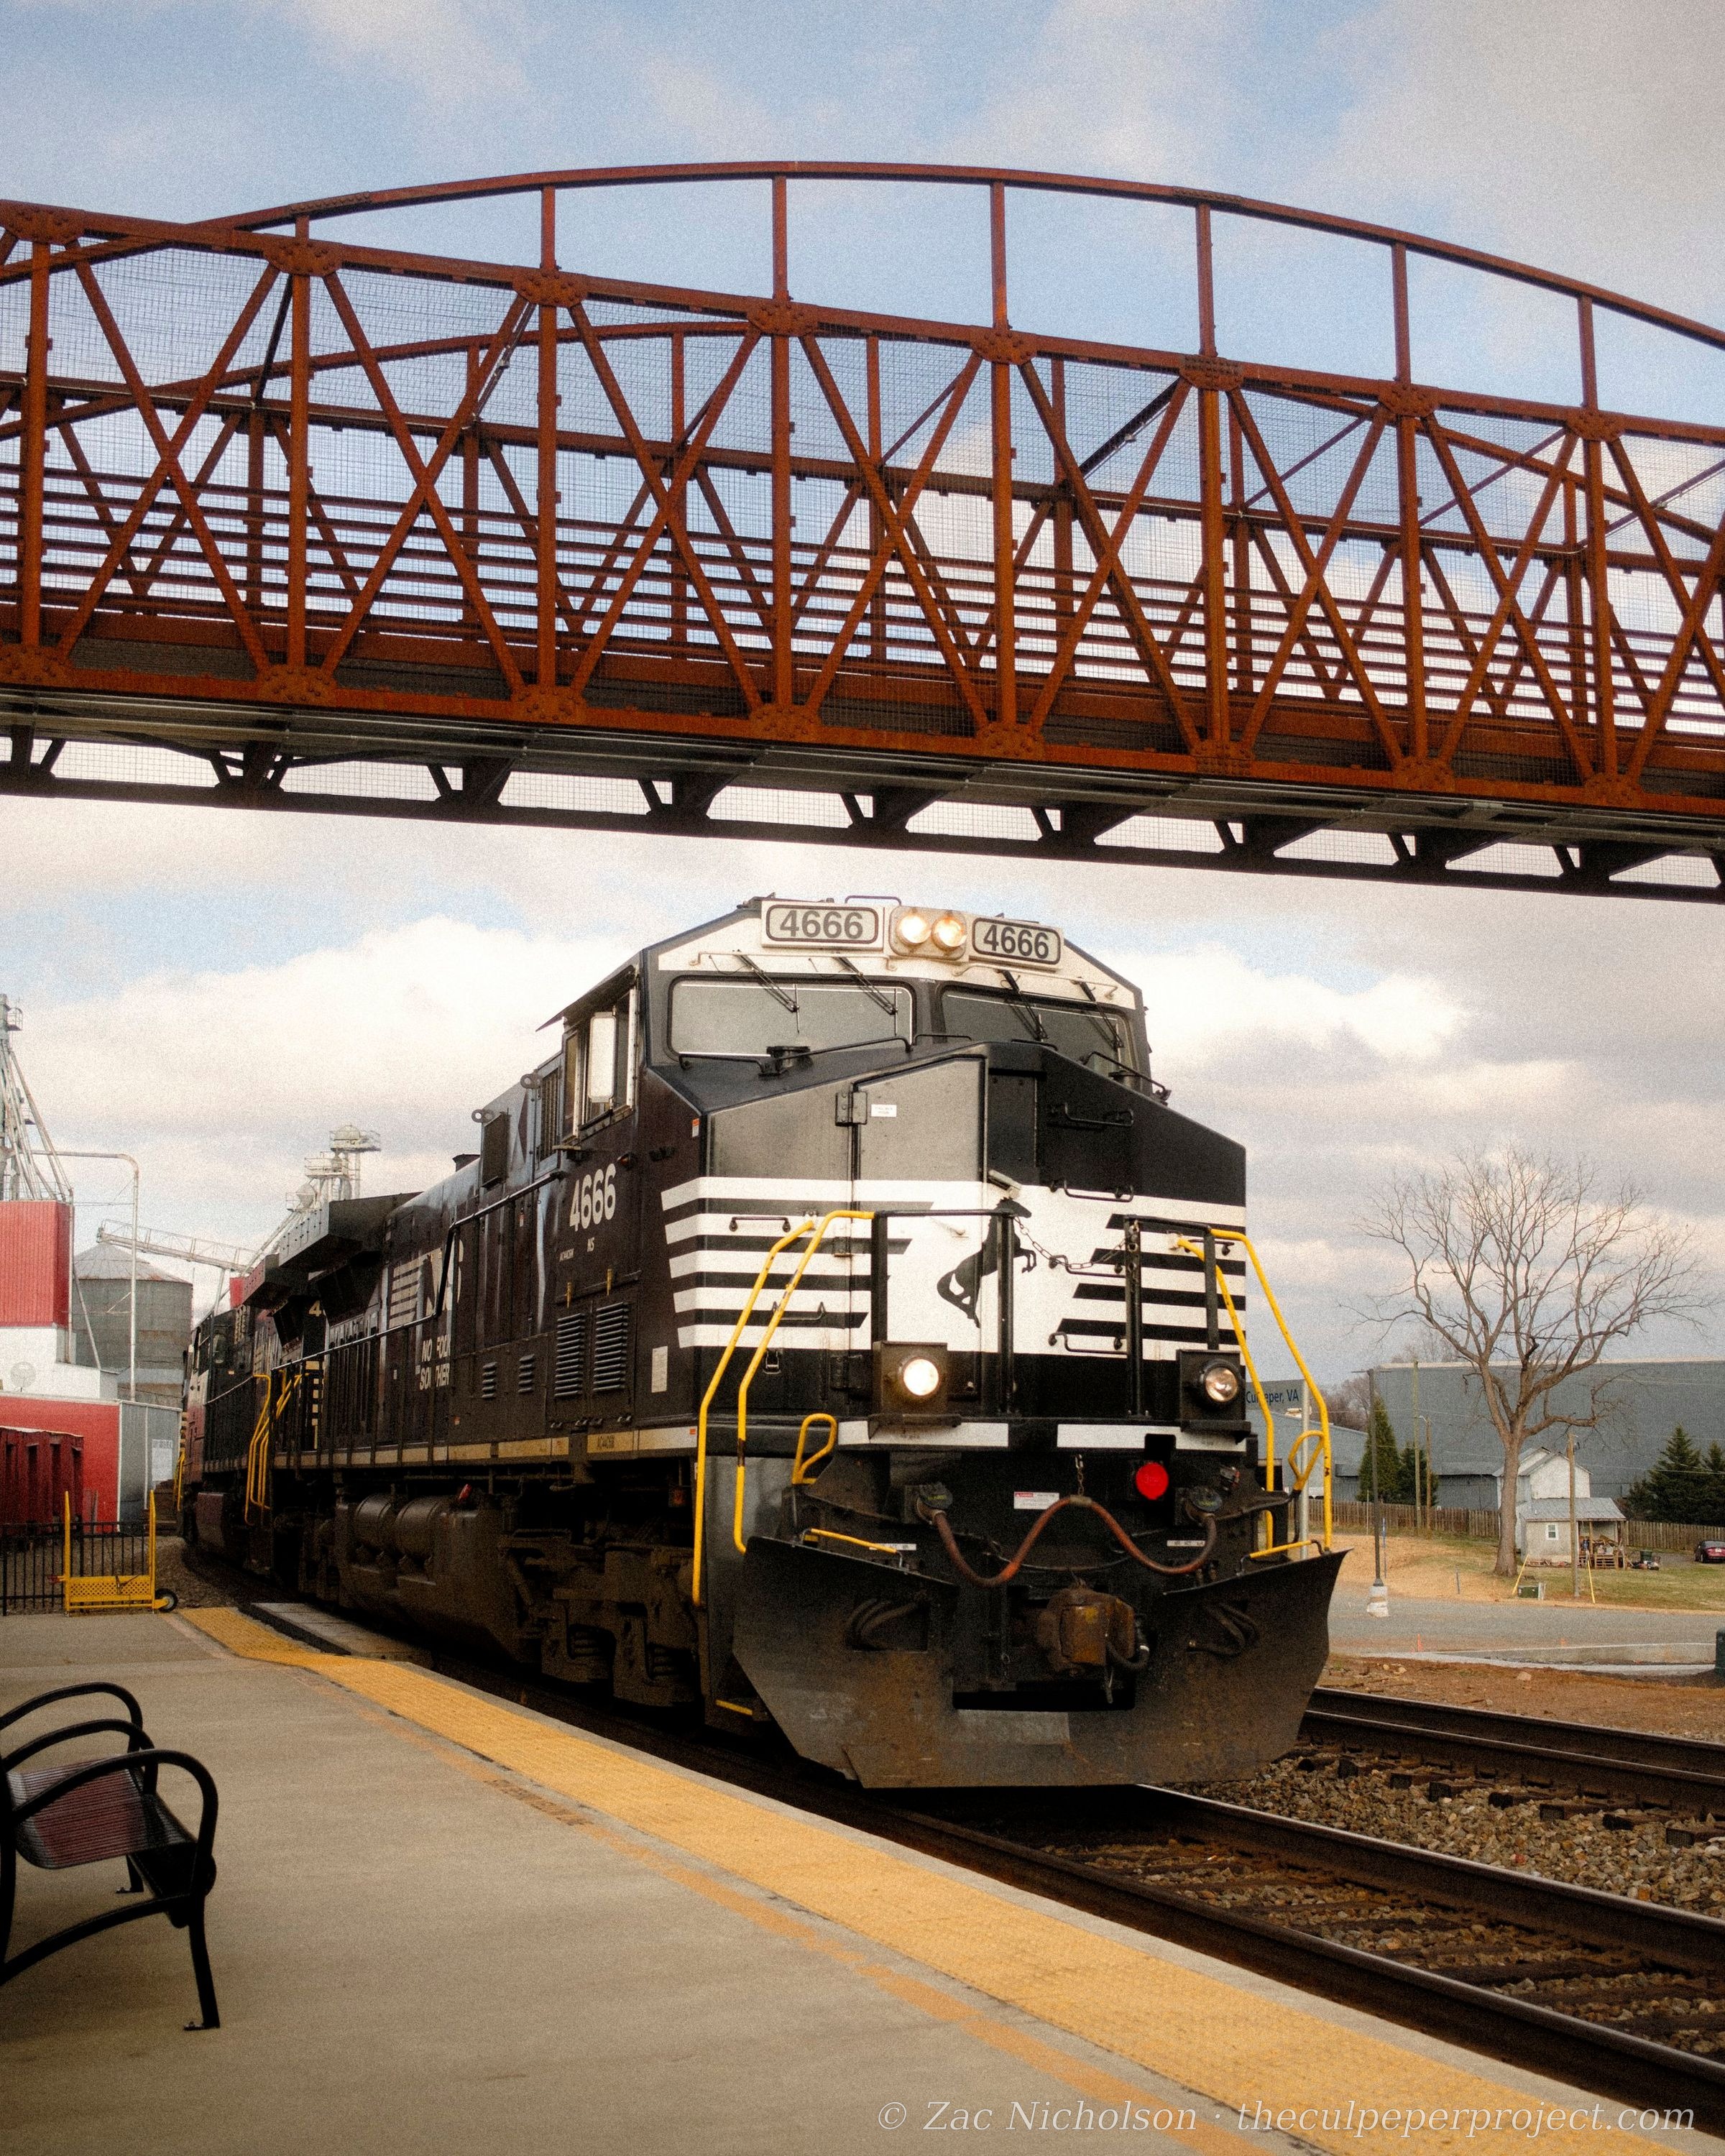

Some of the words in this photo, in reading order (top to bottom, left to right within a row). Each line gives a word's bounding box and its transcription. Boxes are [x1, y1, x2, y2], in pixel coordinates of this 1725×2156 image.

[779, 909, 864, 940] 4666
[983, 923, 1049, 960] 4666
[569, 1163, 616, 1232] 4666
[586, 1237, 594, 1253] NS
[1246, 1391, 1284, 1406] Cueper,
[1287, 1389, 1300, 1402] VA
